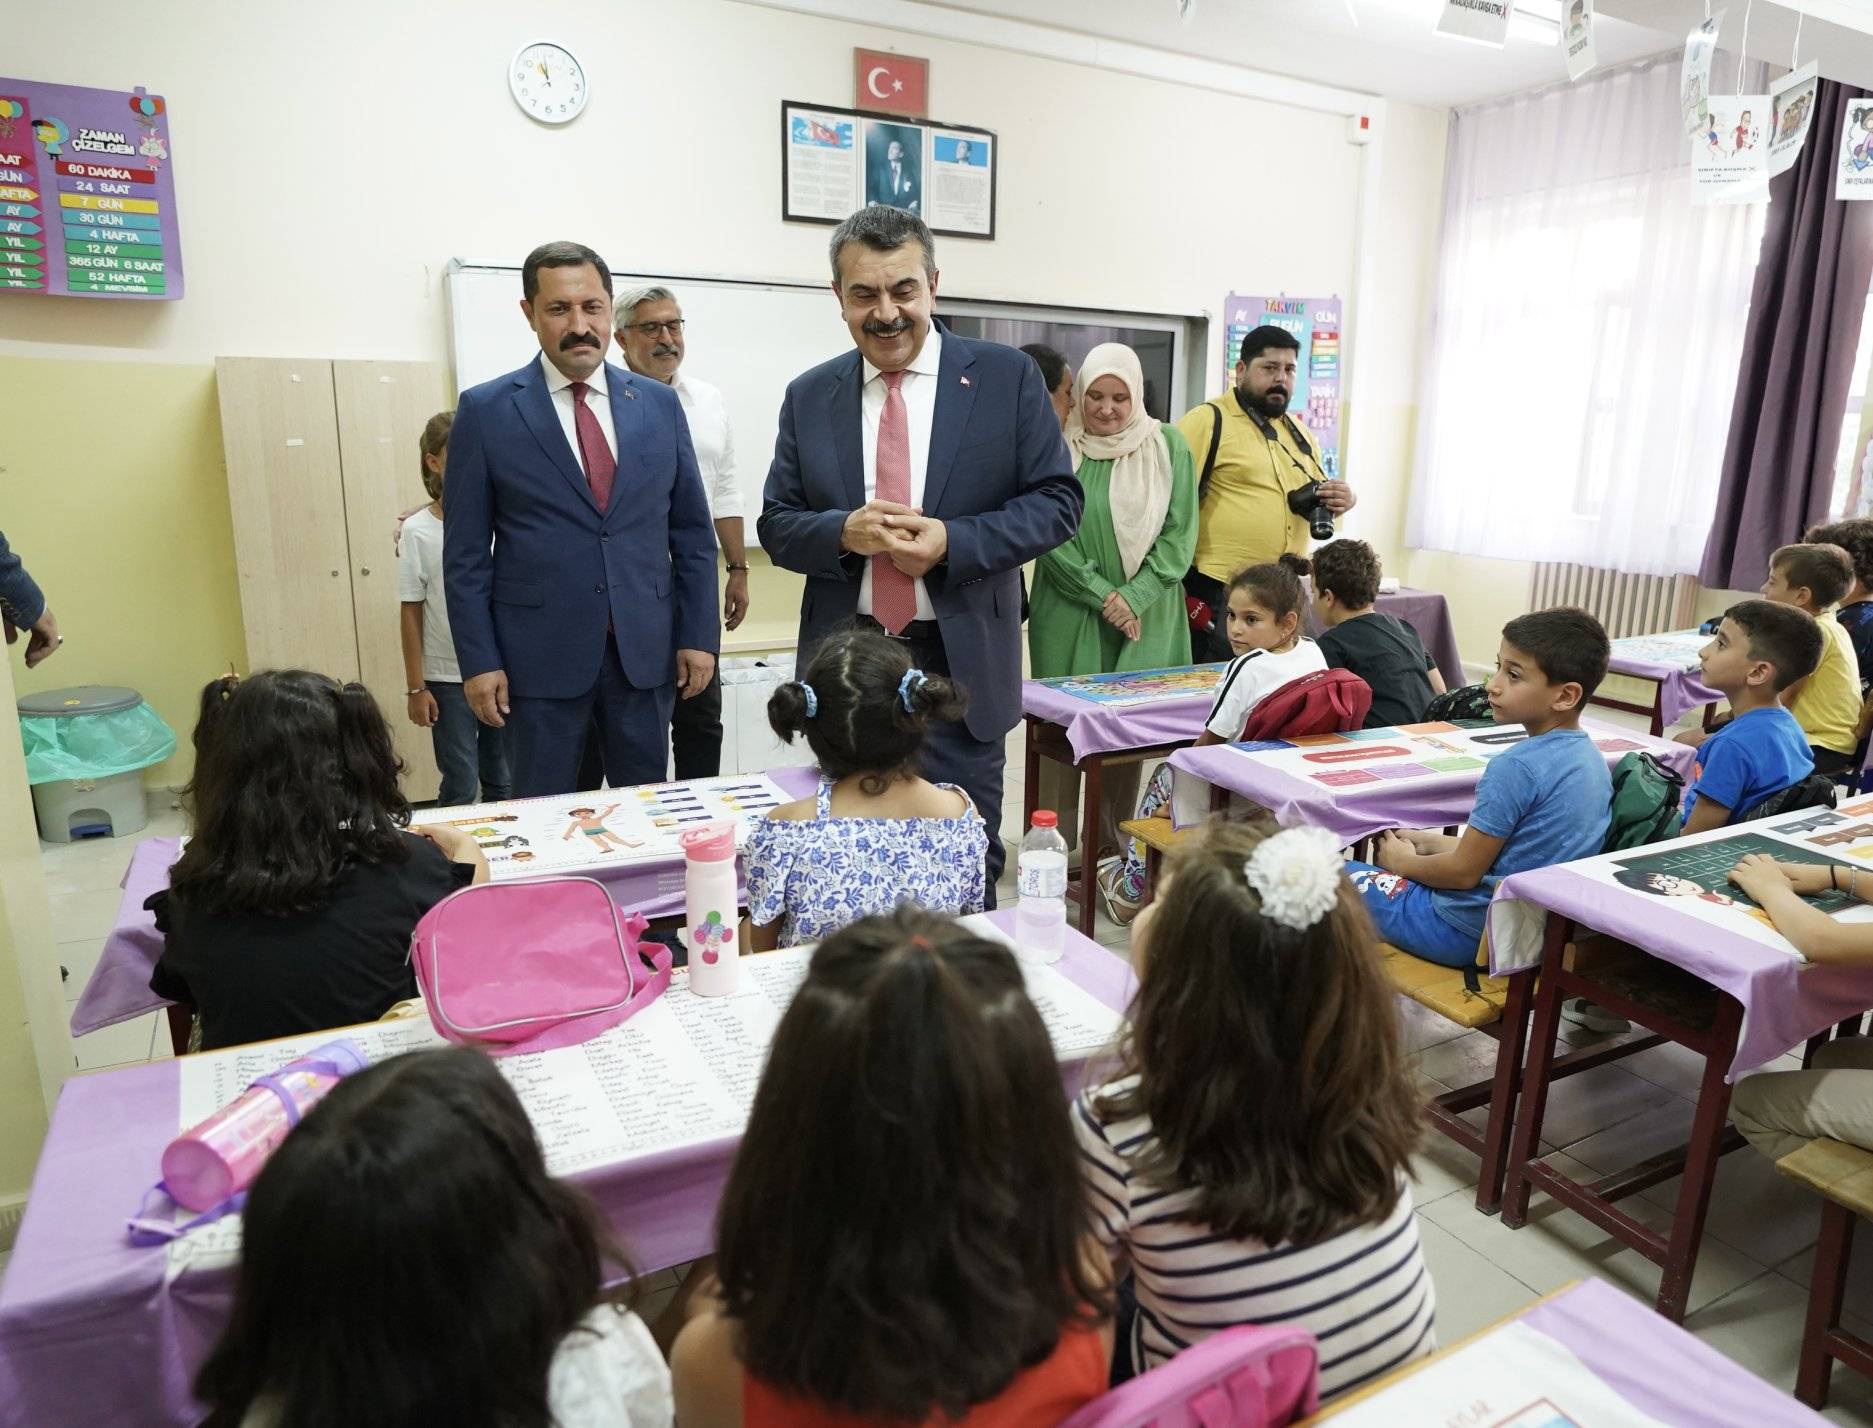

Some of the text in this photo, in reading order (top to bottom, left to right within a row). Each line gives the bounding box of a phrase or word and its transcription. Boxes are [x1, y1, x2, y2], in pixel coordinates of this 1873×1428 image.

[80, 129, 125, 144] ZAMAN
[68, 164, 131, 180] 60 DAKİKA
[76, 181, 131, 194] 24 SAAT
[81, 198, 88, 206] 7
[6, 205, 21, 215] AY
[80, 213, 123, 225] 30 GÜN
[7, 222, 22, 232] AY
[90, 230, 139, 242] 4 HAFTA
[5, 237, 25, 247] YIL
[86, 244, 118, 254] 12 AY
[6, 252, 26, 263] YIL
[69, 256, 164, 272] 365 GÜN 6 SAAT
[7, 267, 26, 277] YIL
[89, 272, 146, 284] 52 HAFTA
